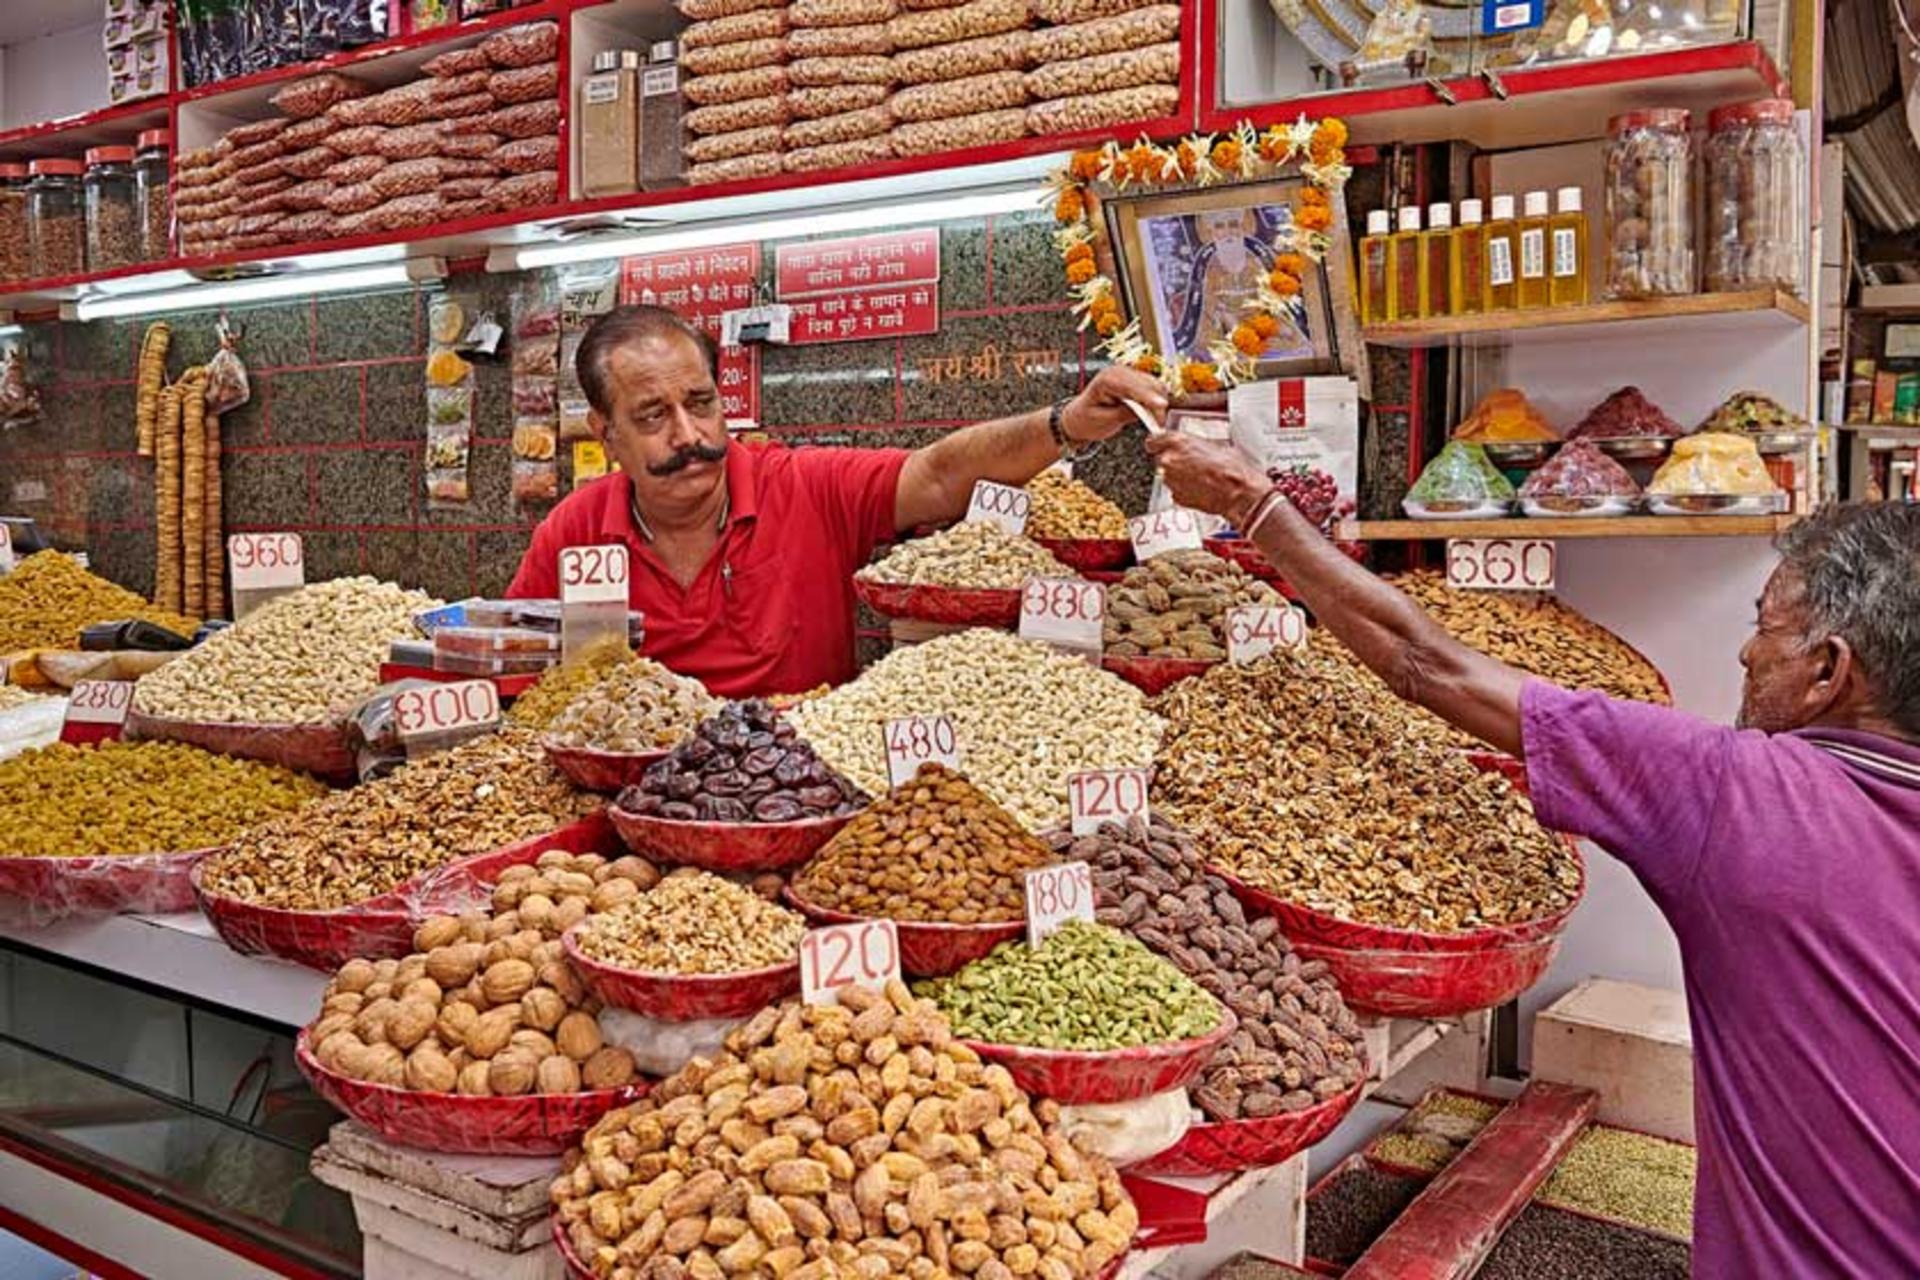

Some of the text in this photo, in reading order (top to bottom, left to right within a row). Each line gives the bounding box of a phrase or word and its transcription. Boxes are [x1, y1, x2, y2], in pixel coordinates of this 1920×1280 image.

[969, 344, 1000, 381] श्री
[974, 483, 1031, 519] 1000
[1130, 510, 1193, 545] 240
[233, 534, 301, 568] 960
[564, 548, 626, 586] 320
[1450, 540, 1554, 586] 660
[1023, 580, 1105, 622] 880
[1230, 608, 1303, 647] 640
[72, 681, 129, 709] 280
[394, 683, 493, 730] 800
[891, 714, 955, 760] 480
[1071, 772, 1143, 817] 120
[802, 922, 896, 991] 120
